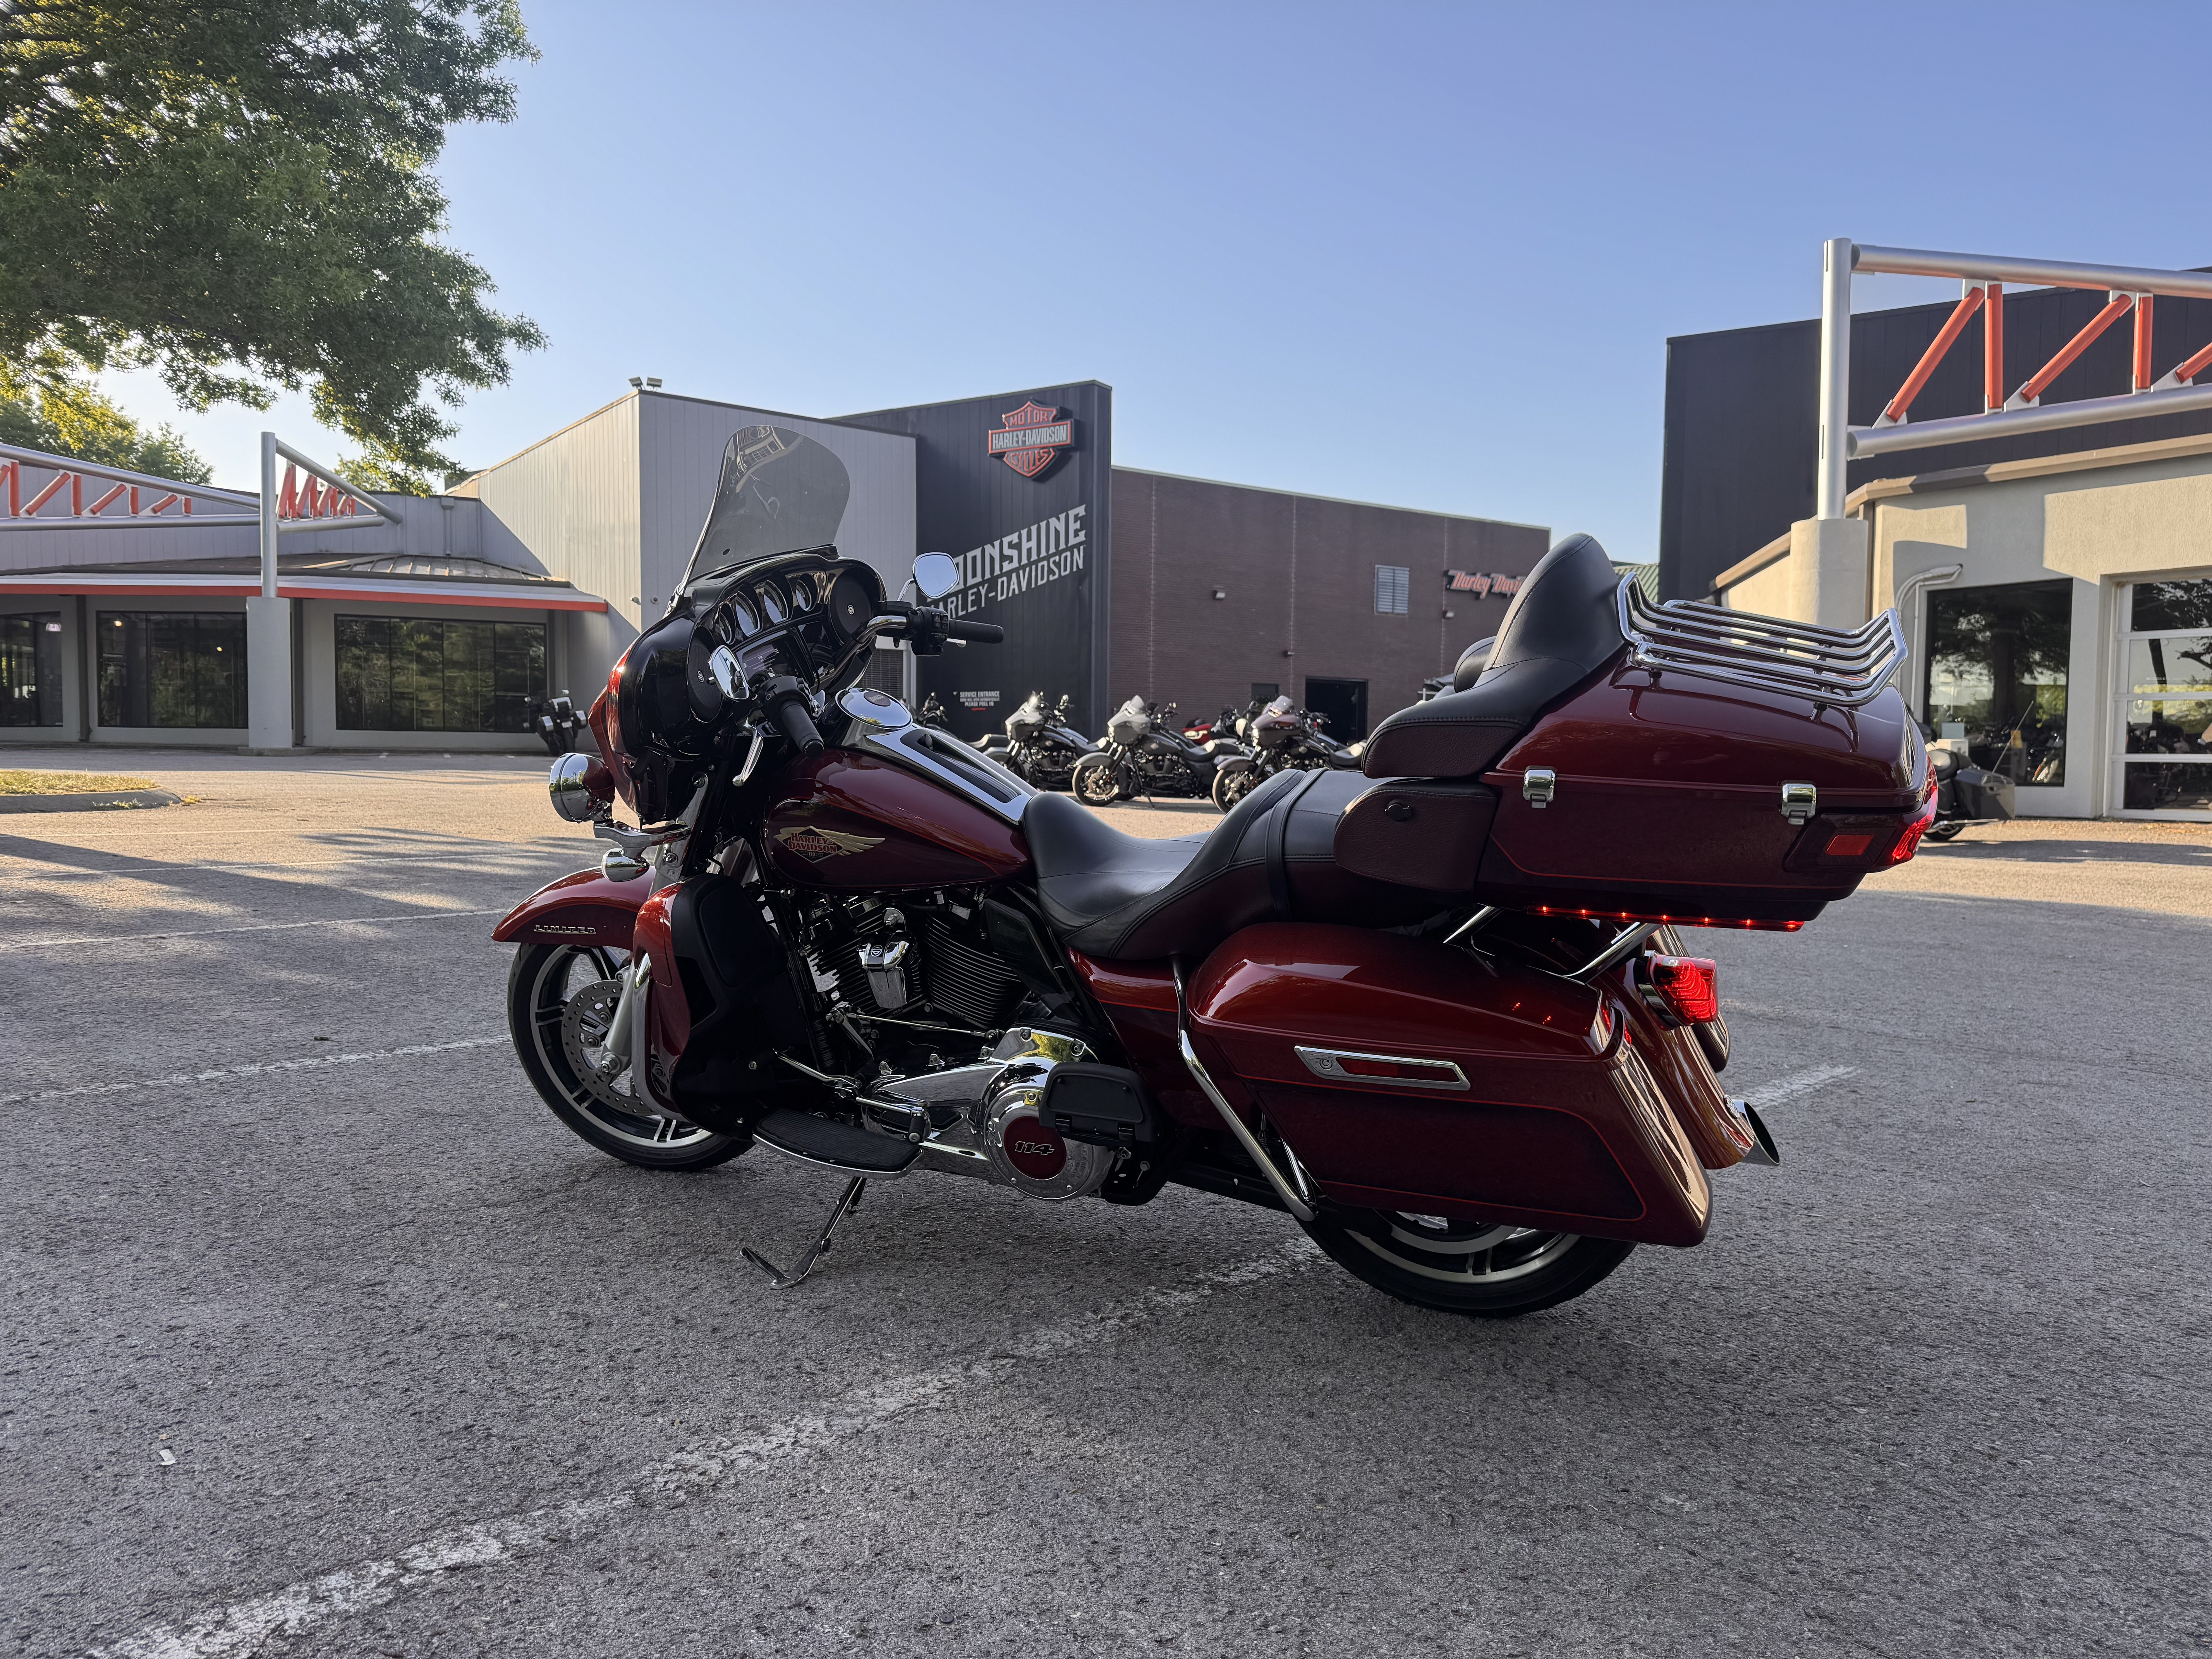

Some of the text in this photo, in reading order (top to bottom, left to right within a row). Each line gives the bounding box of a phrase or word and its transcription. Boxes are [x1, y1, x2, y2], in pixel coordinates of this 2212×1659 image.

[1010, 407, 1048, 426] MOTOR
[993, 425, 1067, 449] HARLEY-DAVIDSON
[1010, 448, 1048, 472] CYCLES
[1490, 574, 1526, 598] Davi
[788, 840, 837, 853] DAVIDSON
[534, 925, 596, 934] LIMITED
[1015, 1141, 1055, 1155] 114
